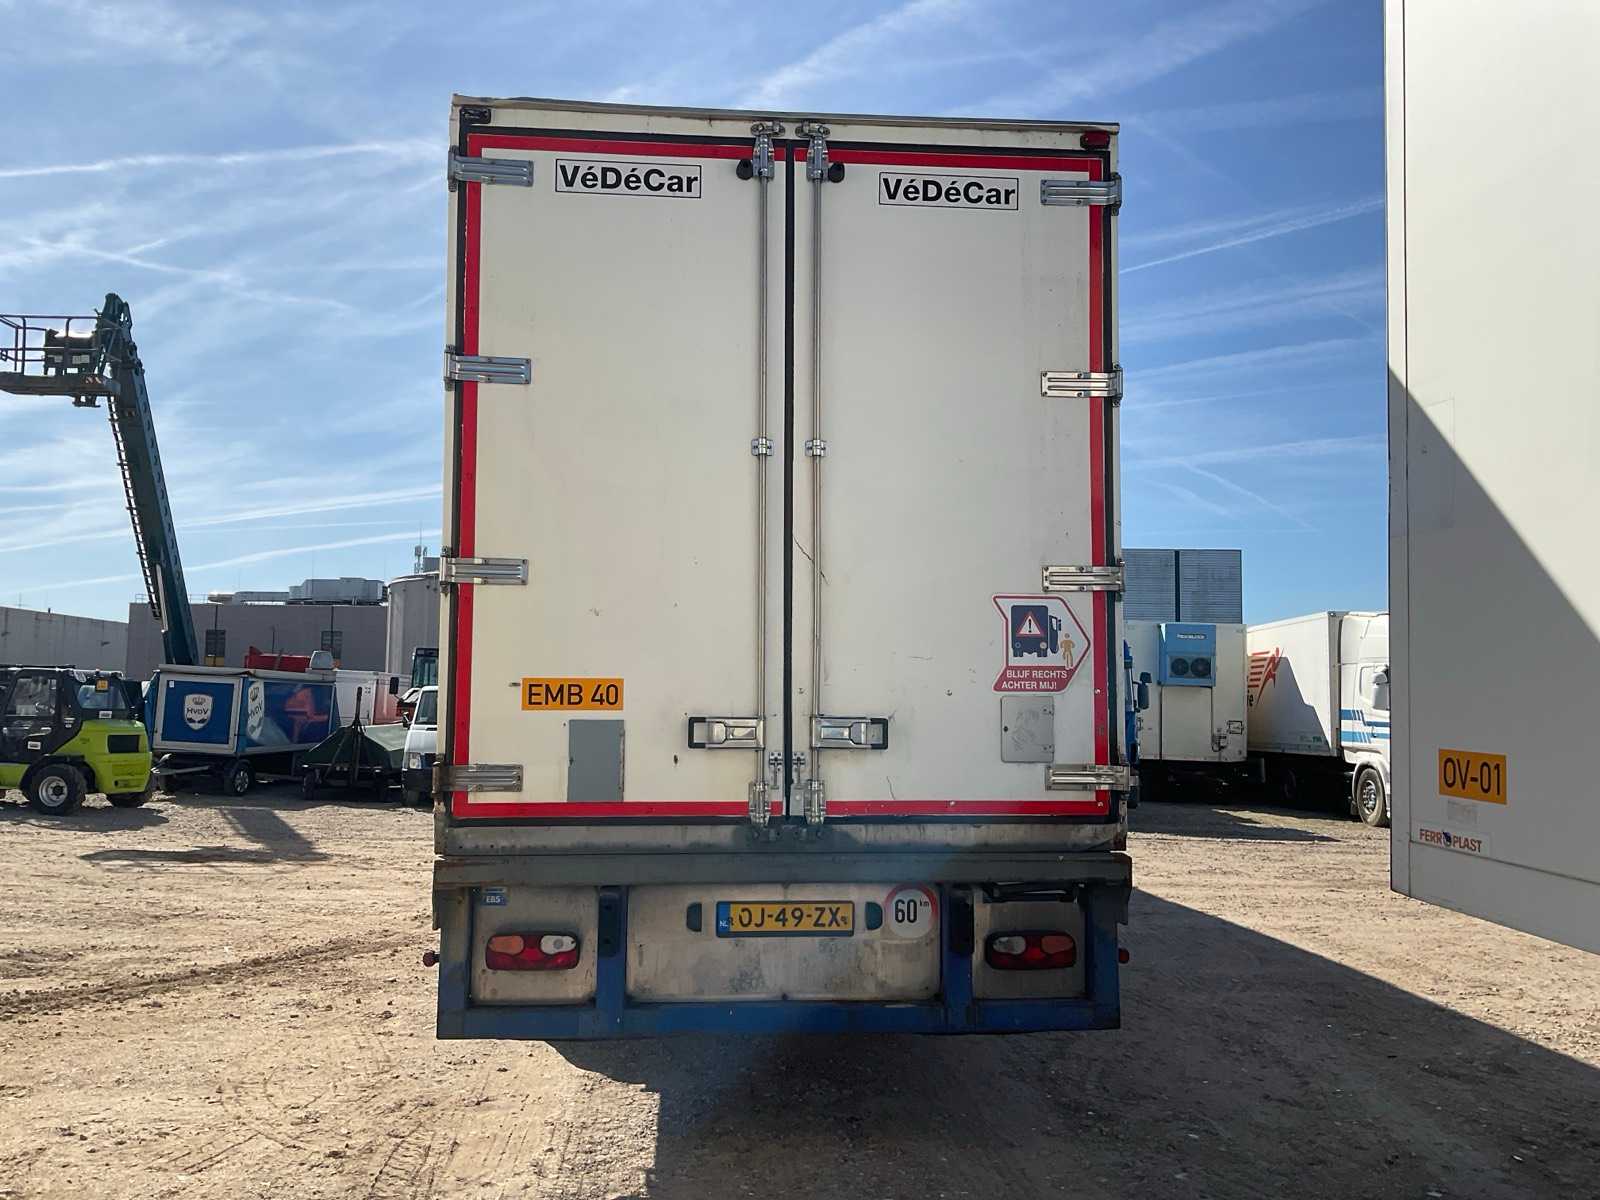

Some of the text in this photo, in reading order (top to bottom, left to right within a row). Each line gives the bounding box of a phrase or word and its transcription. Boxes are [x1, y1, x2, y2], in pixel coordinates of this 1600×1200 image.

[559, 163, 699, 195] VéDéCar
[882, 177, 1017, 206] VéDéCar
[1001, 680, 1057, 690] ACHTER MIJ!
[1006, 669, 1067, 679] BLIJF RECHTS
[528, 683, 619, 706] EMB 40
[1443, 757, 1501, 796] OV-01
[738, 906, 841, 928] OJ-49-ZX
[895, 898, 918, 924] 60
